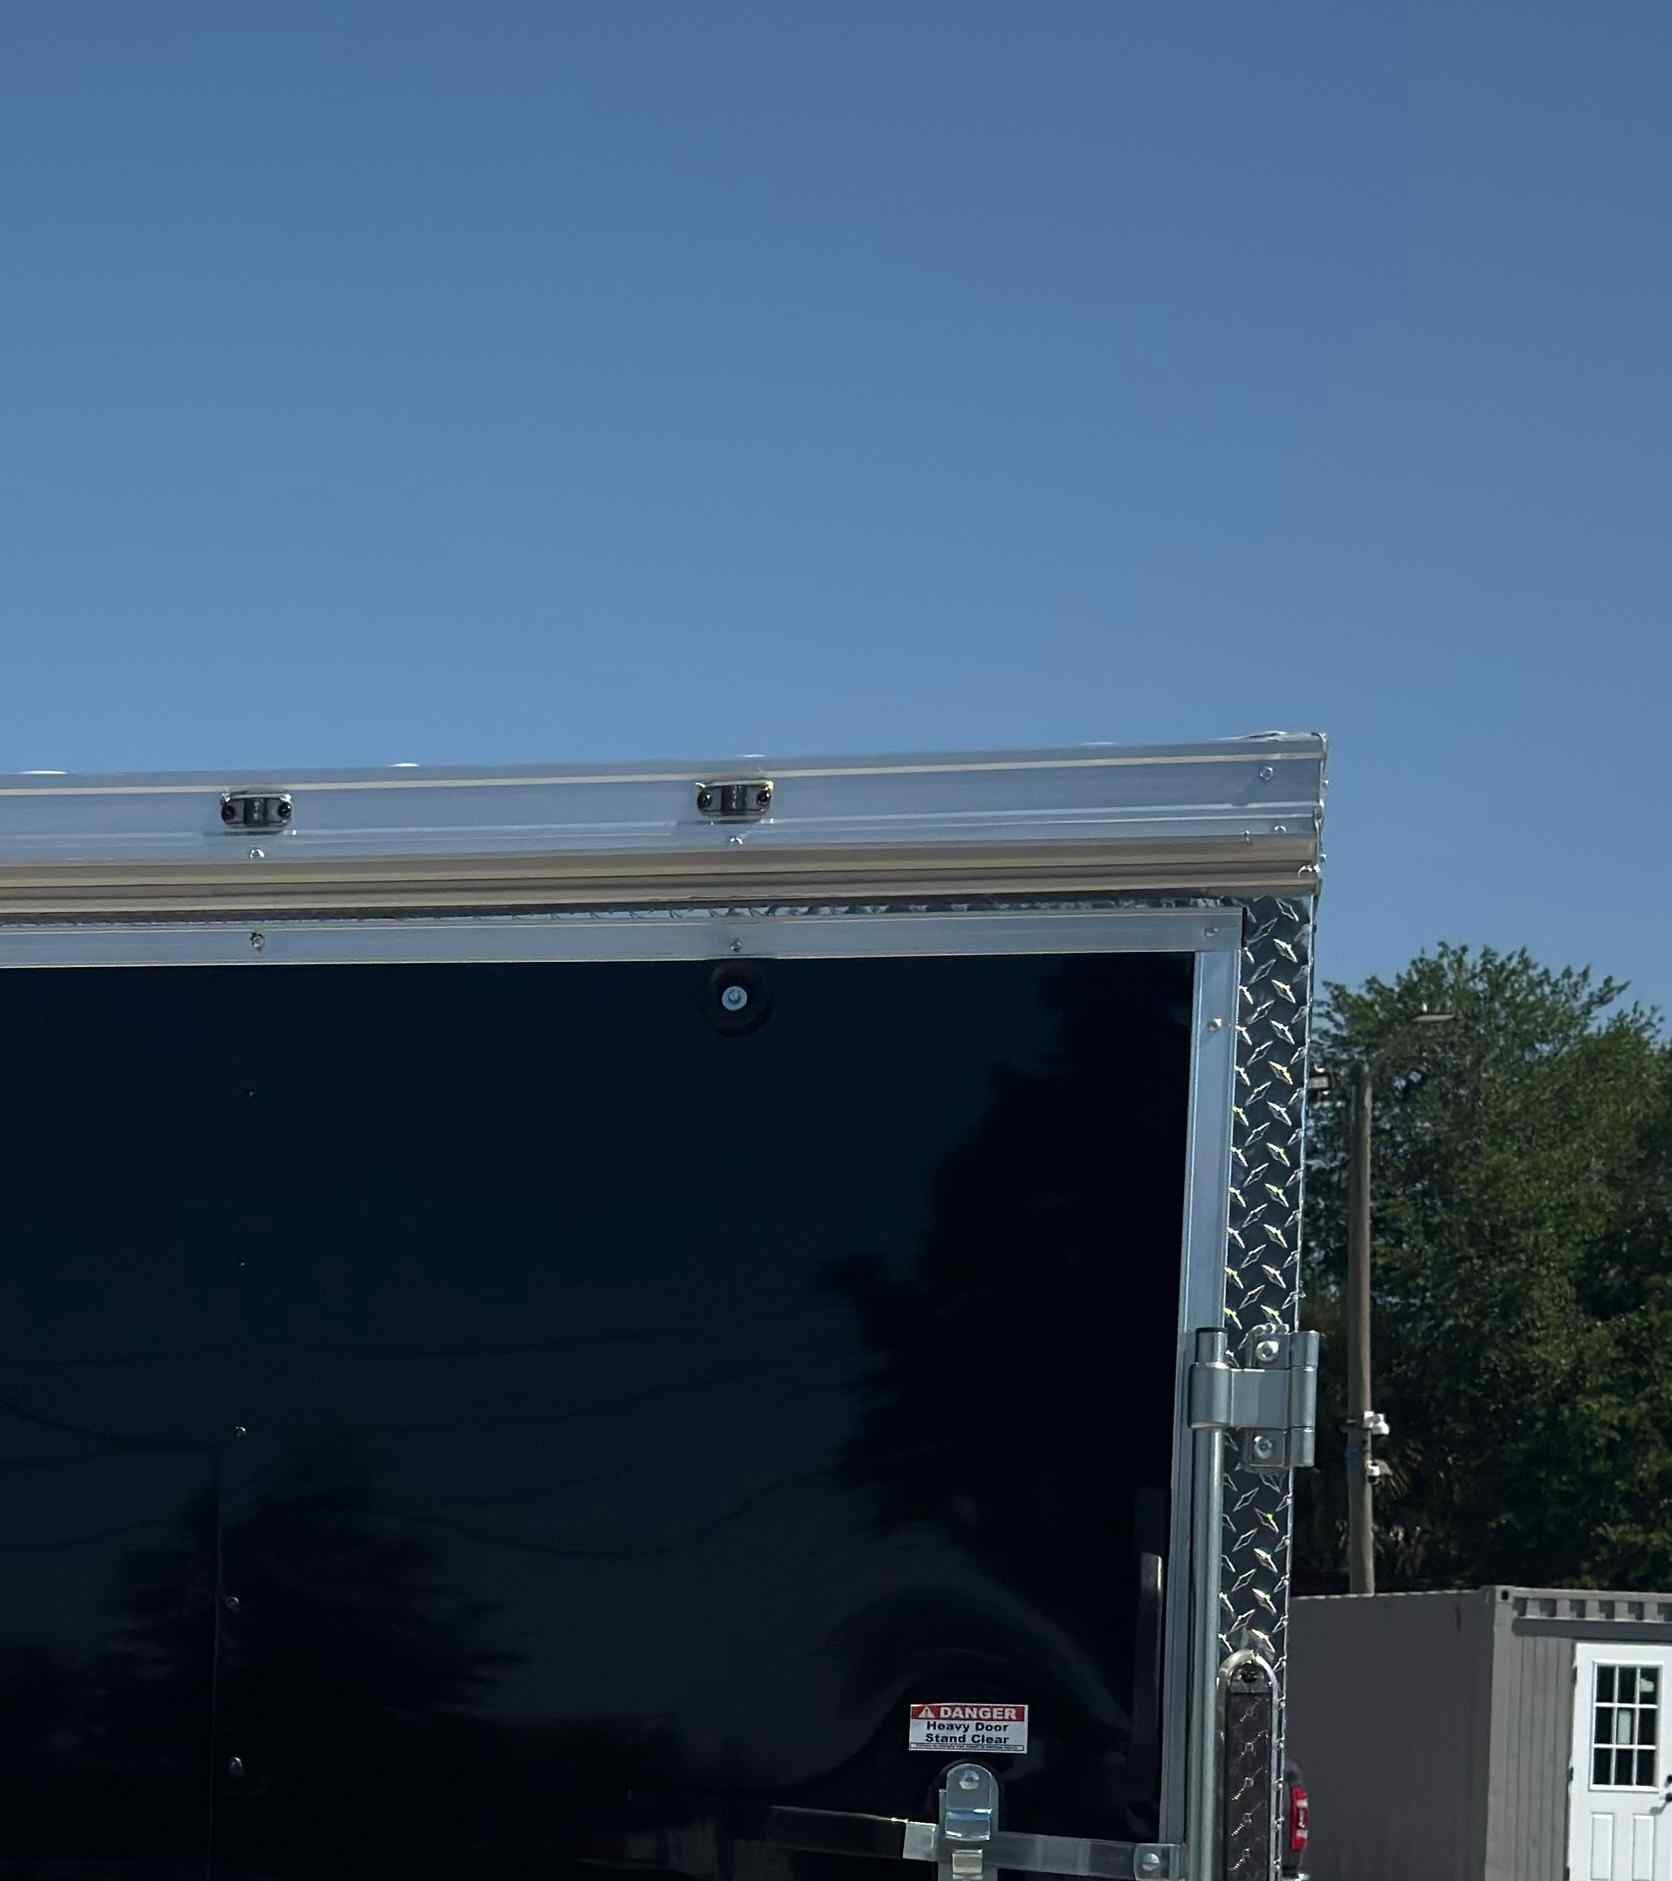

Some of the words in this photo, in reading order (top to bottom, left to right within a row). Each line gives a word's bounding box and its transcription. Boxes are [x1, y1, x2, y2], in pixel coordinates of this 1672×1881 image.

[939, 1706, 1017, 1720] DANGER
[926, 1721, 970, 1732] Heavy
[975, 1722, 1009, 1732] Door
[925, 1732, 966, 1743] Stand
[971, 1733, 1010, 1744] Clear
